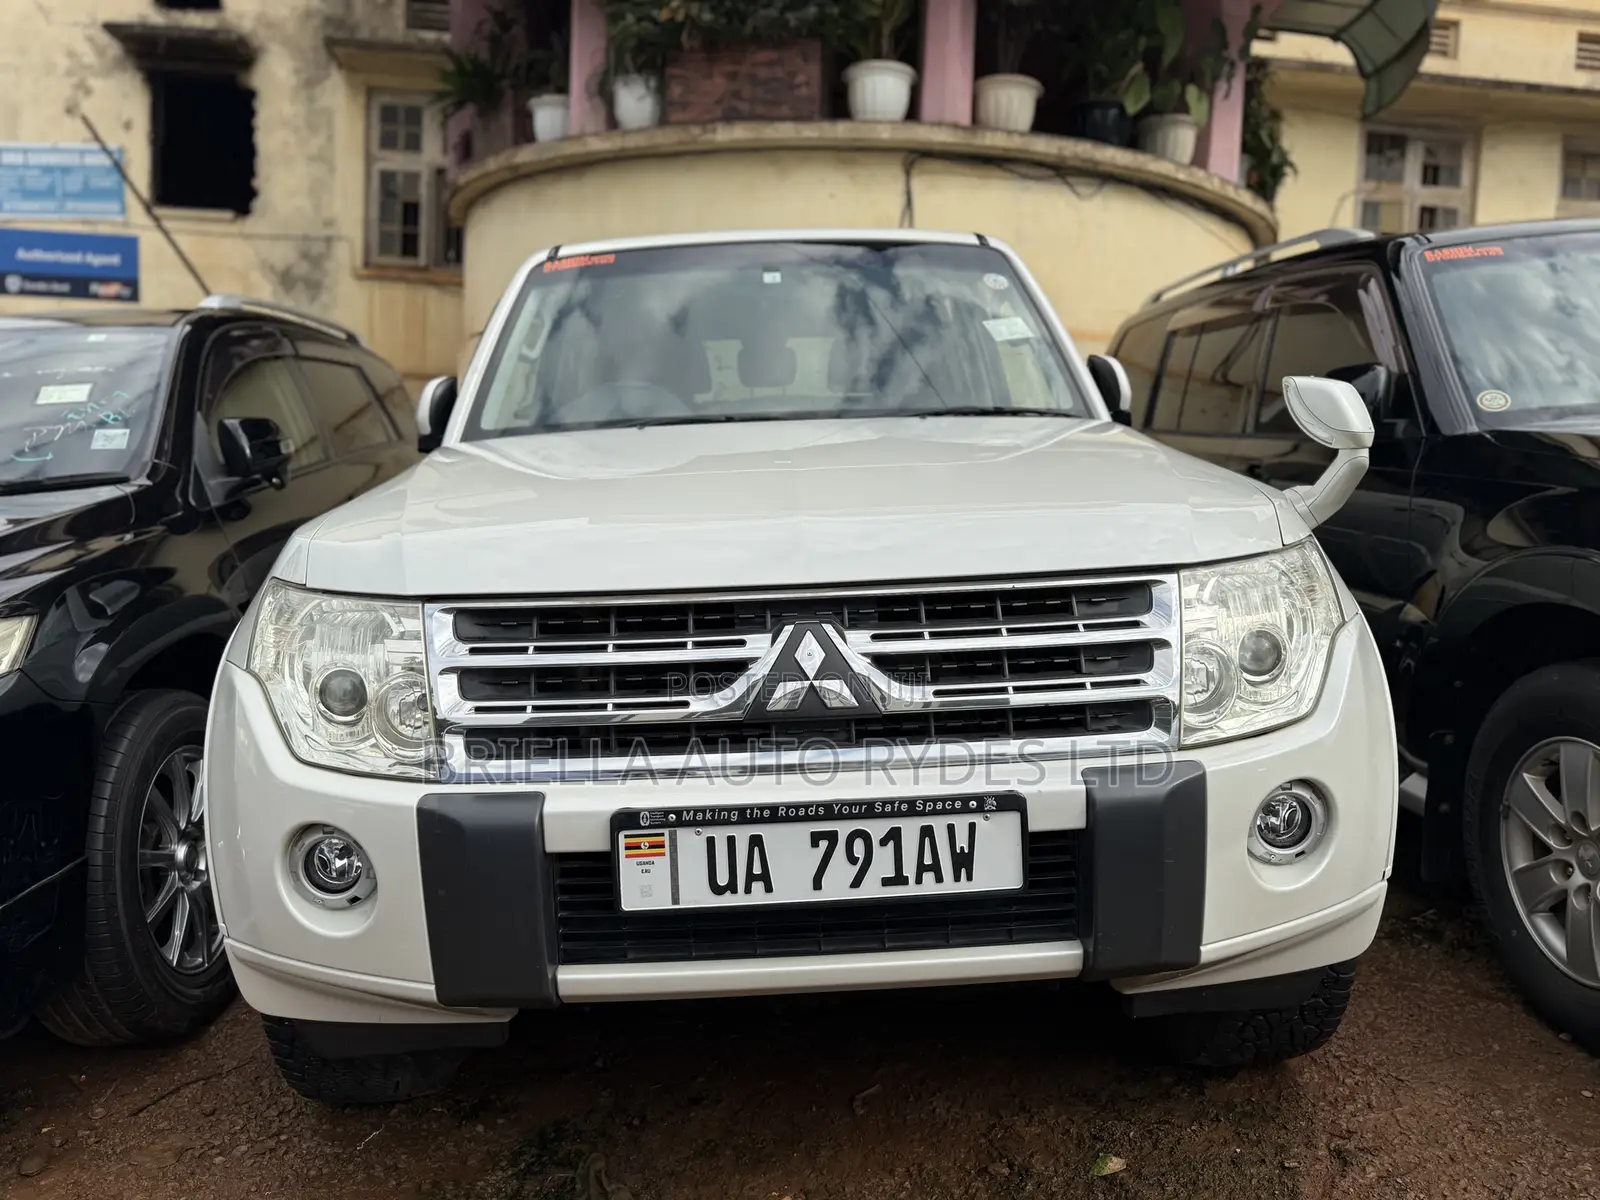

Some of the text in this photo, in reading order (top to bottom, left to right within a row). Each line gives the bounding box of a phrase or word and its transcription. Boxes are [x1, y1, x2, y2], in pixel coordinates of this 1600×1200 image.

[682, 800, 962, 822] Making the Roads Your Safe Space
[706, 822, 977, 896] UA 791AW
